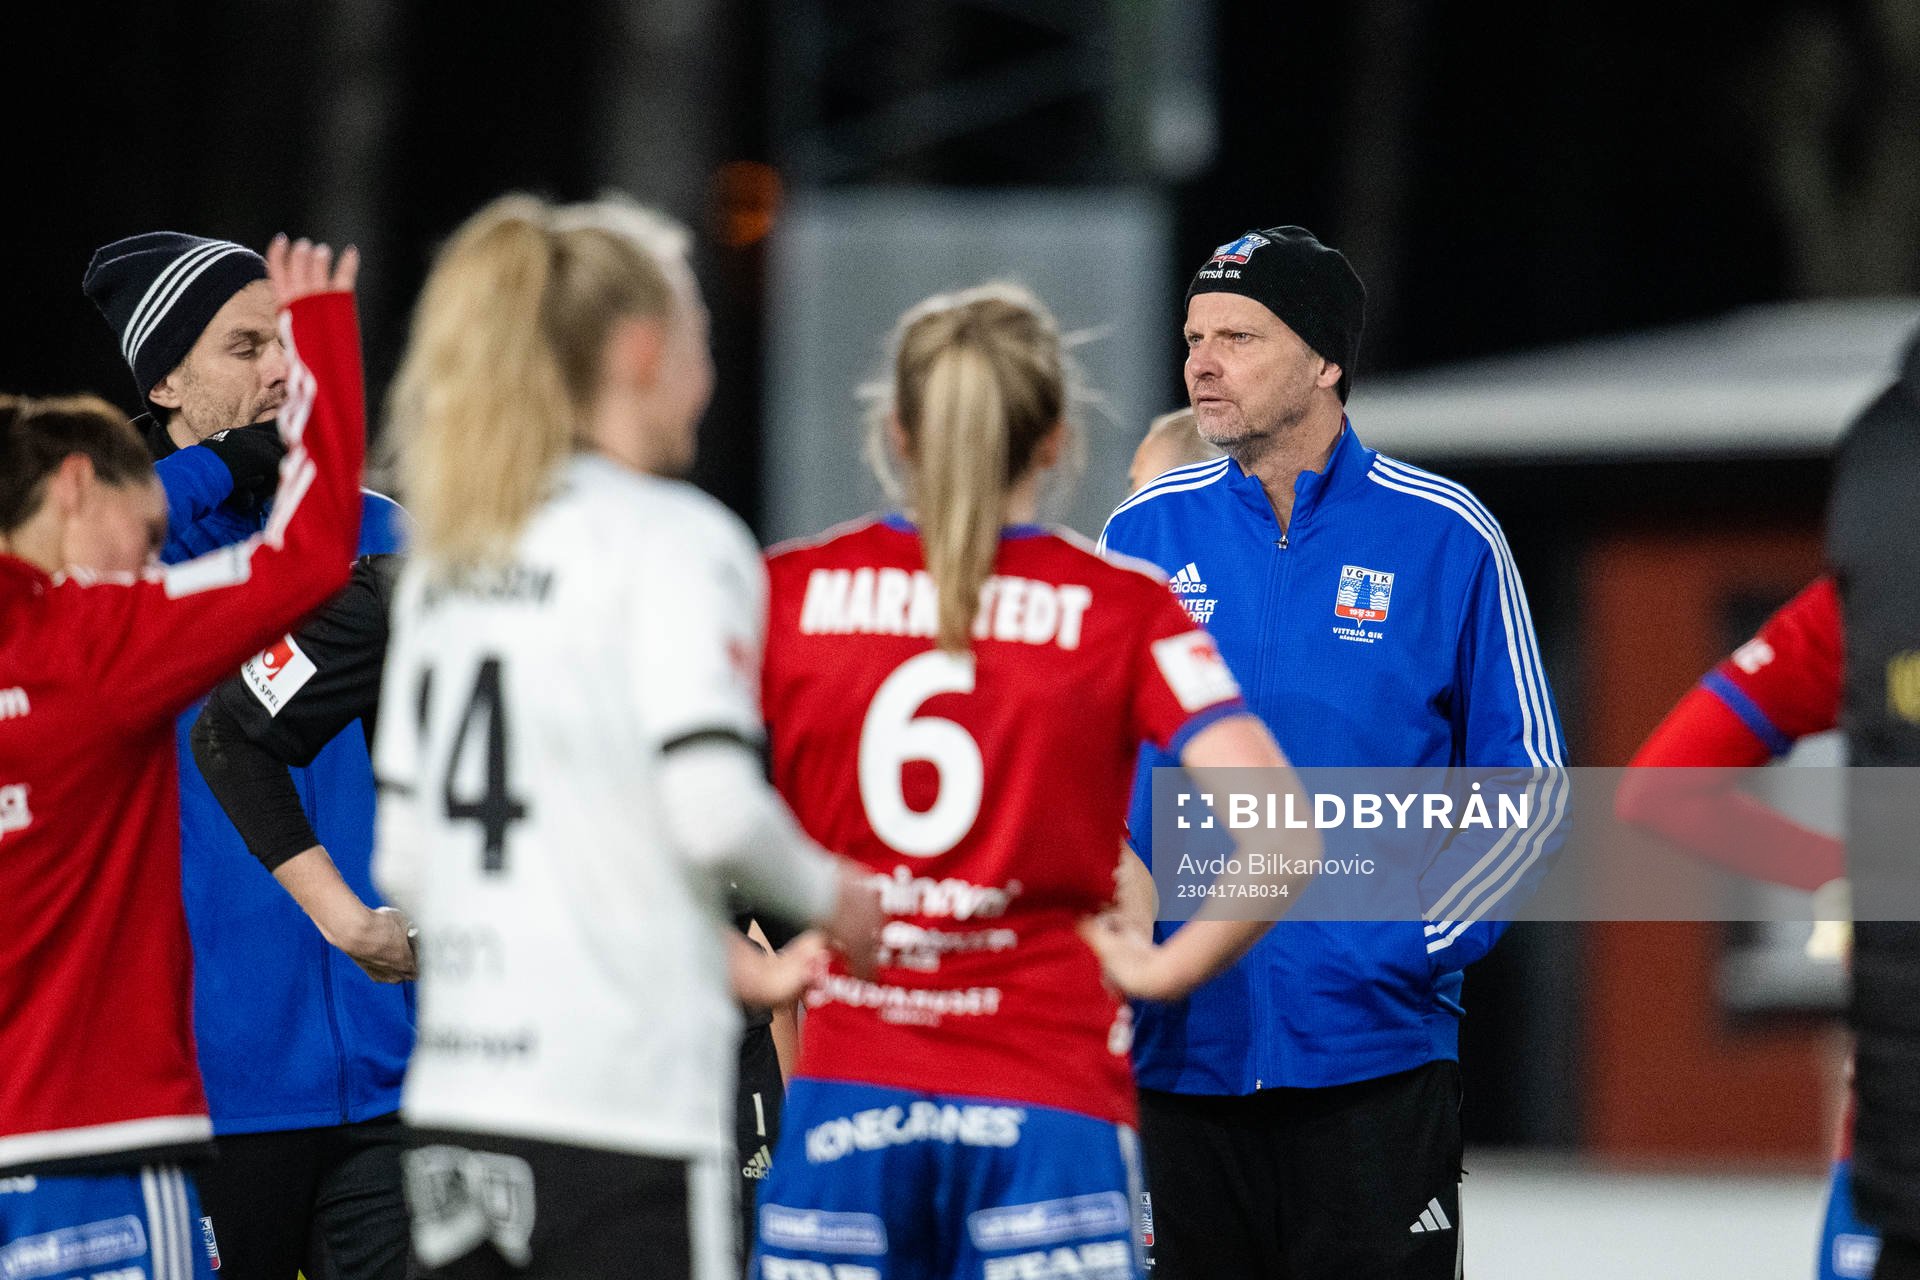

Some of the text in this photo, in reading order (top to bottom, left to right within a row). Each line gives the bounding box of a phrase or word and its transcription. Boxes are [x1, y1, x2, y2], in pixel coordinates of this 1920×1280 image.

[1225, 269, 1241, 279] GIK
[1168, 580, 1207, 594] didas
[1333, 627, 1383, 639] VITTSJÖ GIK
[858, 649, 984, 858] 6
